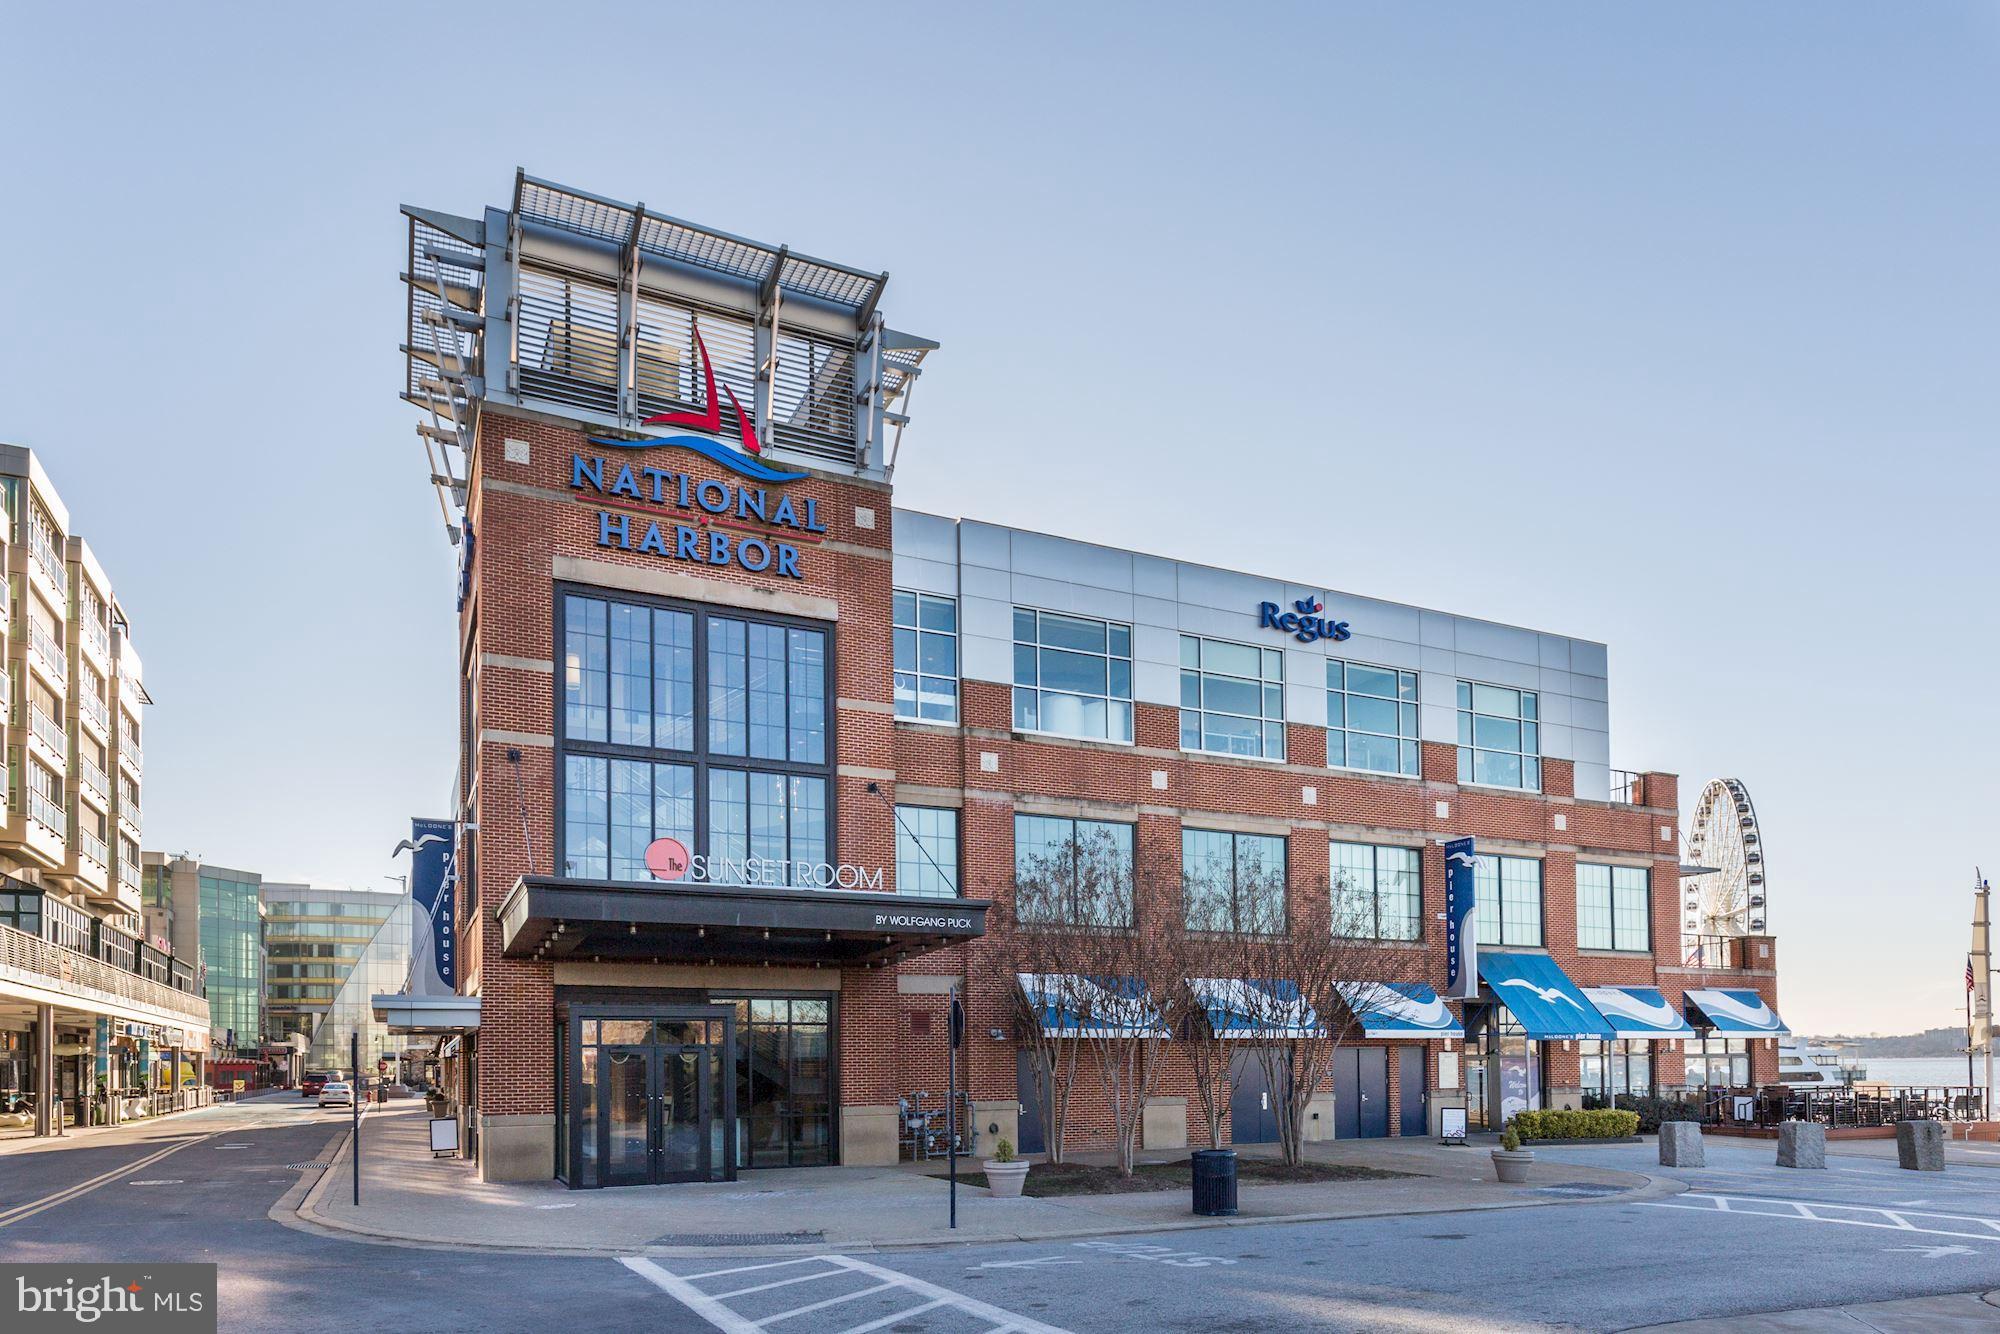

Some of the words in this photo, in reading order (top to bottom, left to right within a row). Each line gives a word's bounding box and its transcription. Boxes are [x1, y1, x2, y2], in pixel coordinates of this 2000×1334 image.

[570, 453, 827, 534] NATIONAL
[597, 510, 803, 579] HARBOR
[1259, 601, 1351, 643] Regus
[668, 858, 683, 872] The
[691, 855, 791, 885] SUNSET
[796, 862, 883, 890] ROOM
[875, 914, 888, 925] BY
[889, 915, 946, 928] WOLFGANG
[947, 918, 972, 929] PUCK
[442, 910, 450, 975] house
[1575, 1032, 1585, 1040] pier
